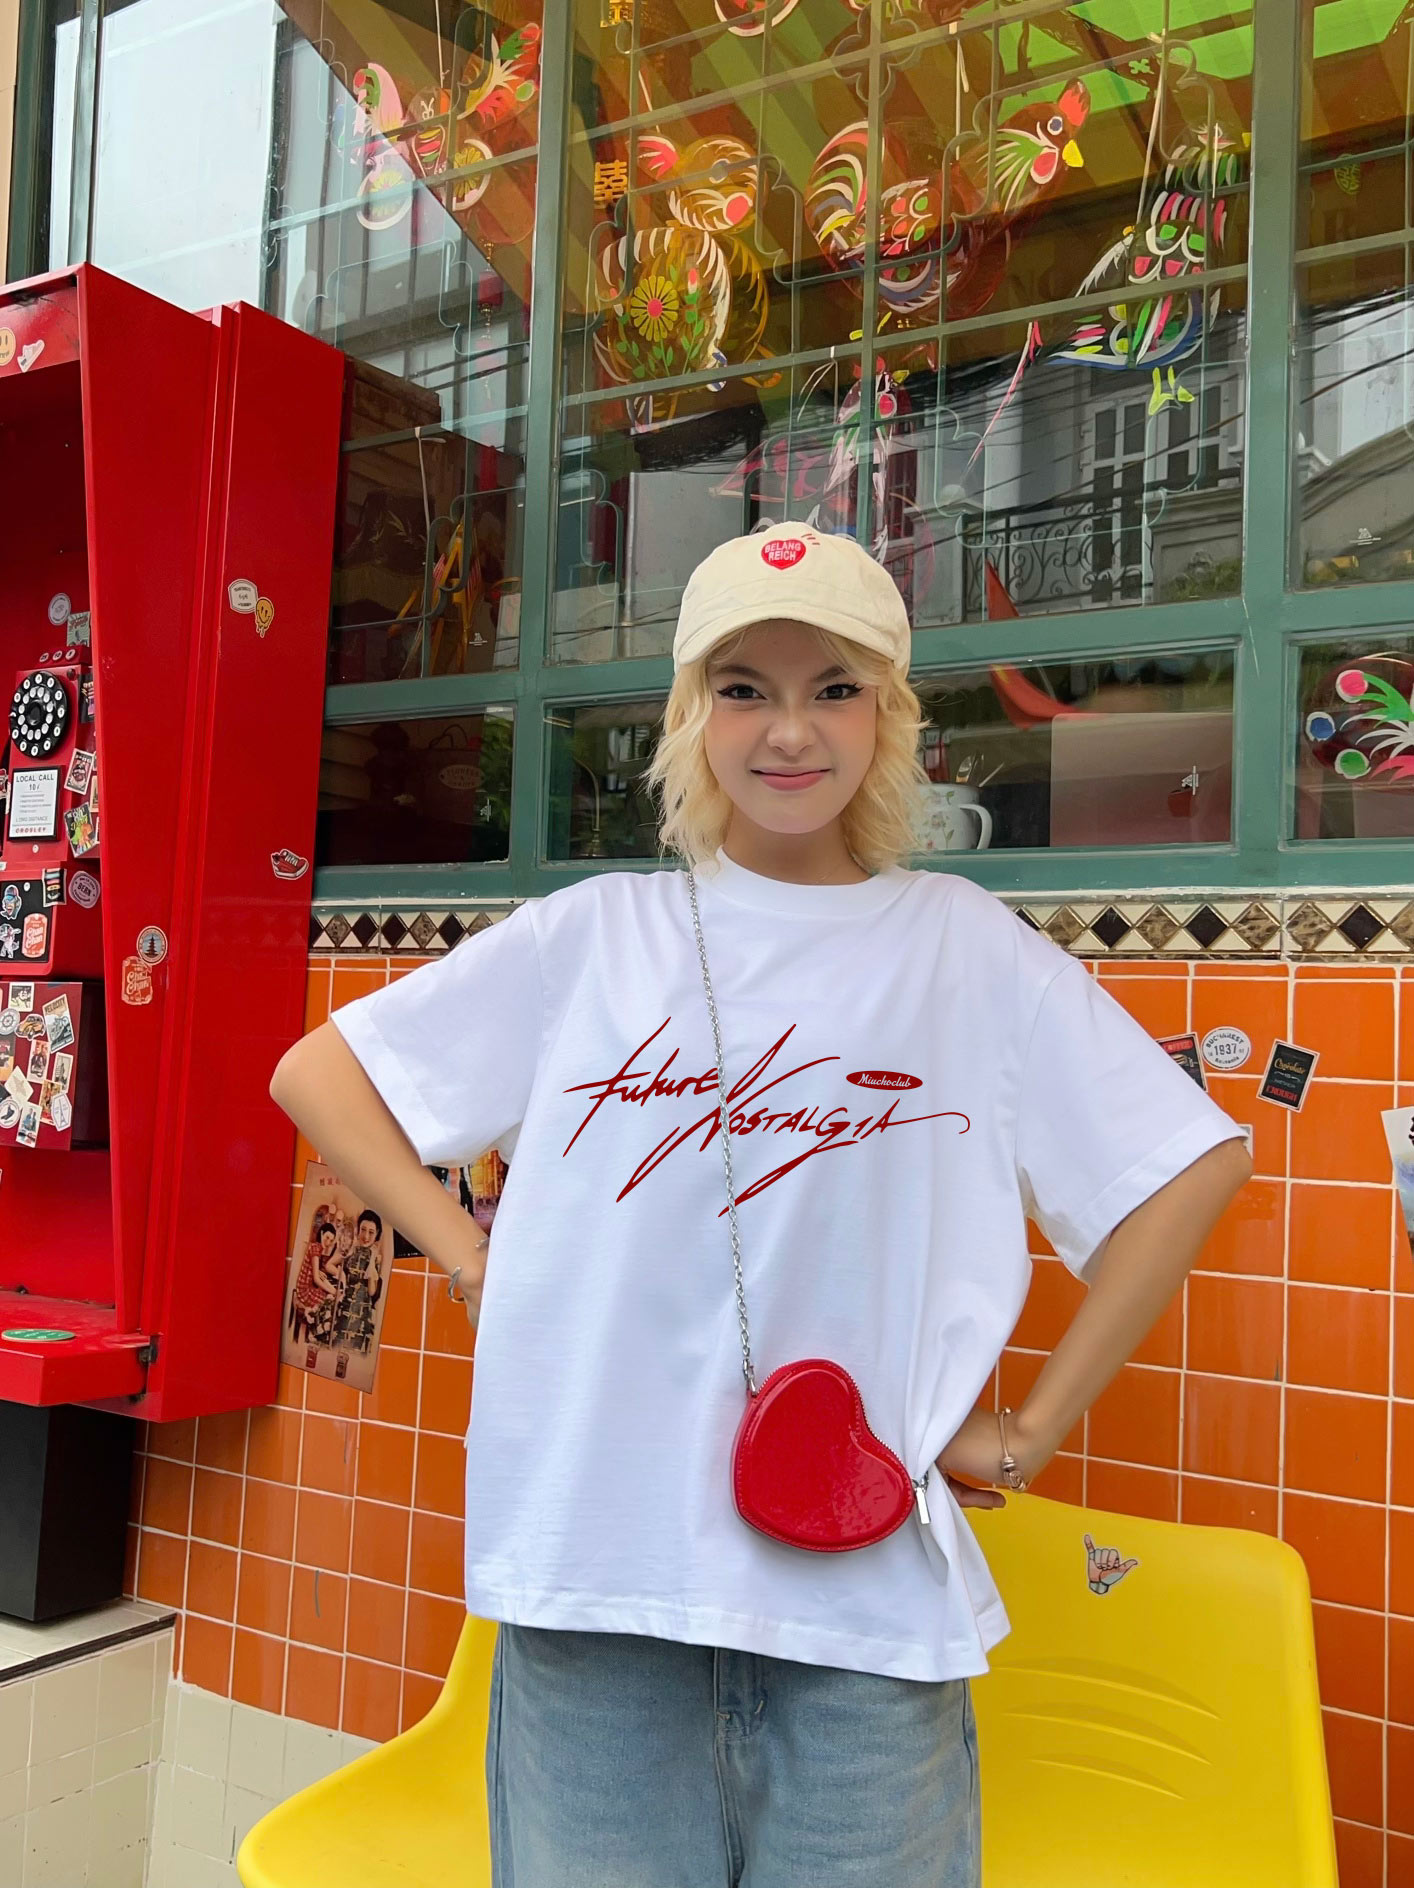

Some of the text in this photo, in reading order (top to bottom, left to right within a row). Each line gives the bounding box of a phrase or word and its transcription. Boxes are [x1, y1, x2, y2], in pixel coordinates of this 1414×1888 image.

[764, 541, 802, 554] BELANG
[768, 550, 797, 563] REICH
[16, 774, 54, 783] LOCAL CALL
[857, 1072, 912, 1088] Miuchoclub
